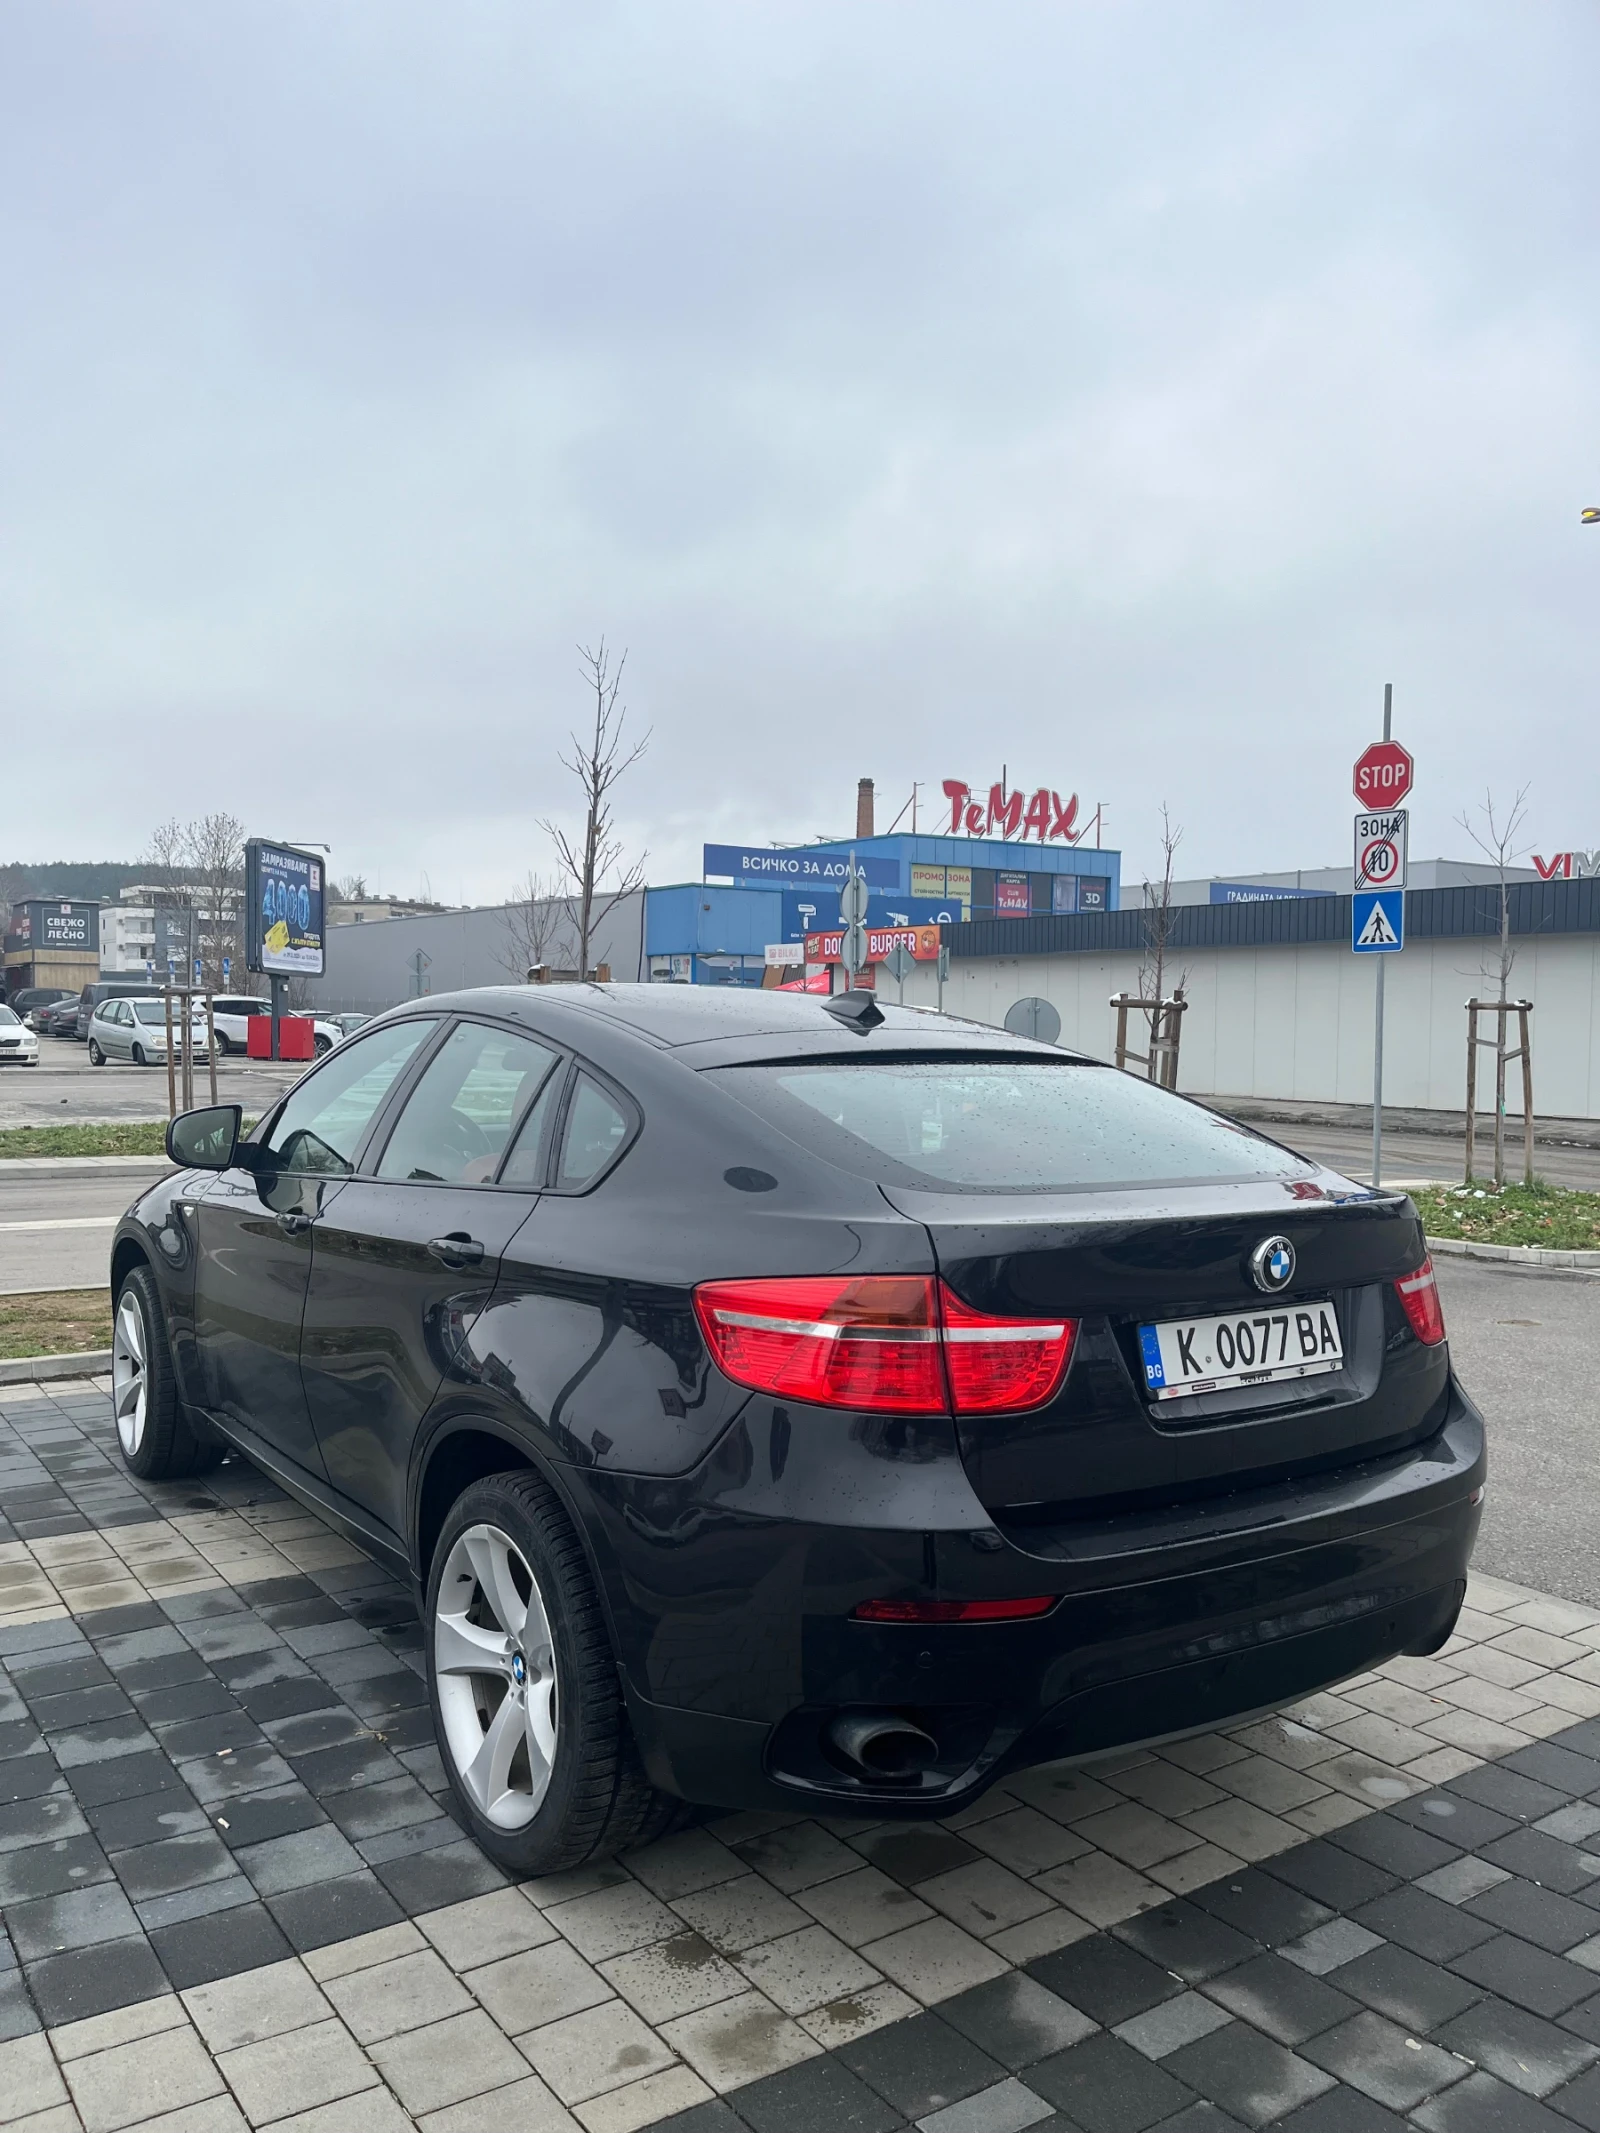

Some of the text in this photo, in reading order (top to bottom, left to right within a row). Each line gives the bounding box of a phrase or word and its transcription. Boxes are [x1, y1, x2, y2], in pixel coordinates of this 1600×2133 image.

[1359, 763, 1406, 790] STOP
[942, 778, 1080, 842] TeMAX
[1360, 818, 1400, 837] ЗОНА
[261, 851, 308, 874] ЗАМРАЗЯВАМЕ
[742, 856, 799, 873] ВСИЧКО
[803, 861, 819, 874] ЗА
[1371, 850, 1389, 872] 10
[913, 872, 971, 883] ПРОМО ЗОНА
[262, 878, 310, 930] 4000
[1085, 892, 1100, 904] 3D
[1227, 891, 1274, 902] ГРАДИНАТА
[47, 917, 85, 927] СВЕЖО
[47, 930, 85, 940] ЛЕСНО
[870, 933, 916, 953] BURGER
[777, 947, 799, 958] BILKA
[1267, 1242, 1292, 1258] BMW
[1177, 1310, 1338, 1376] K 0077 BA
[1147, 1364, 1162, 1380] BG
